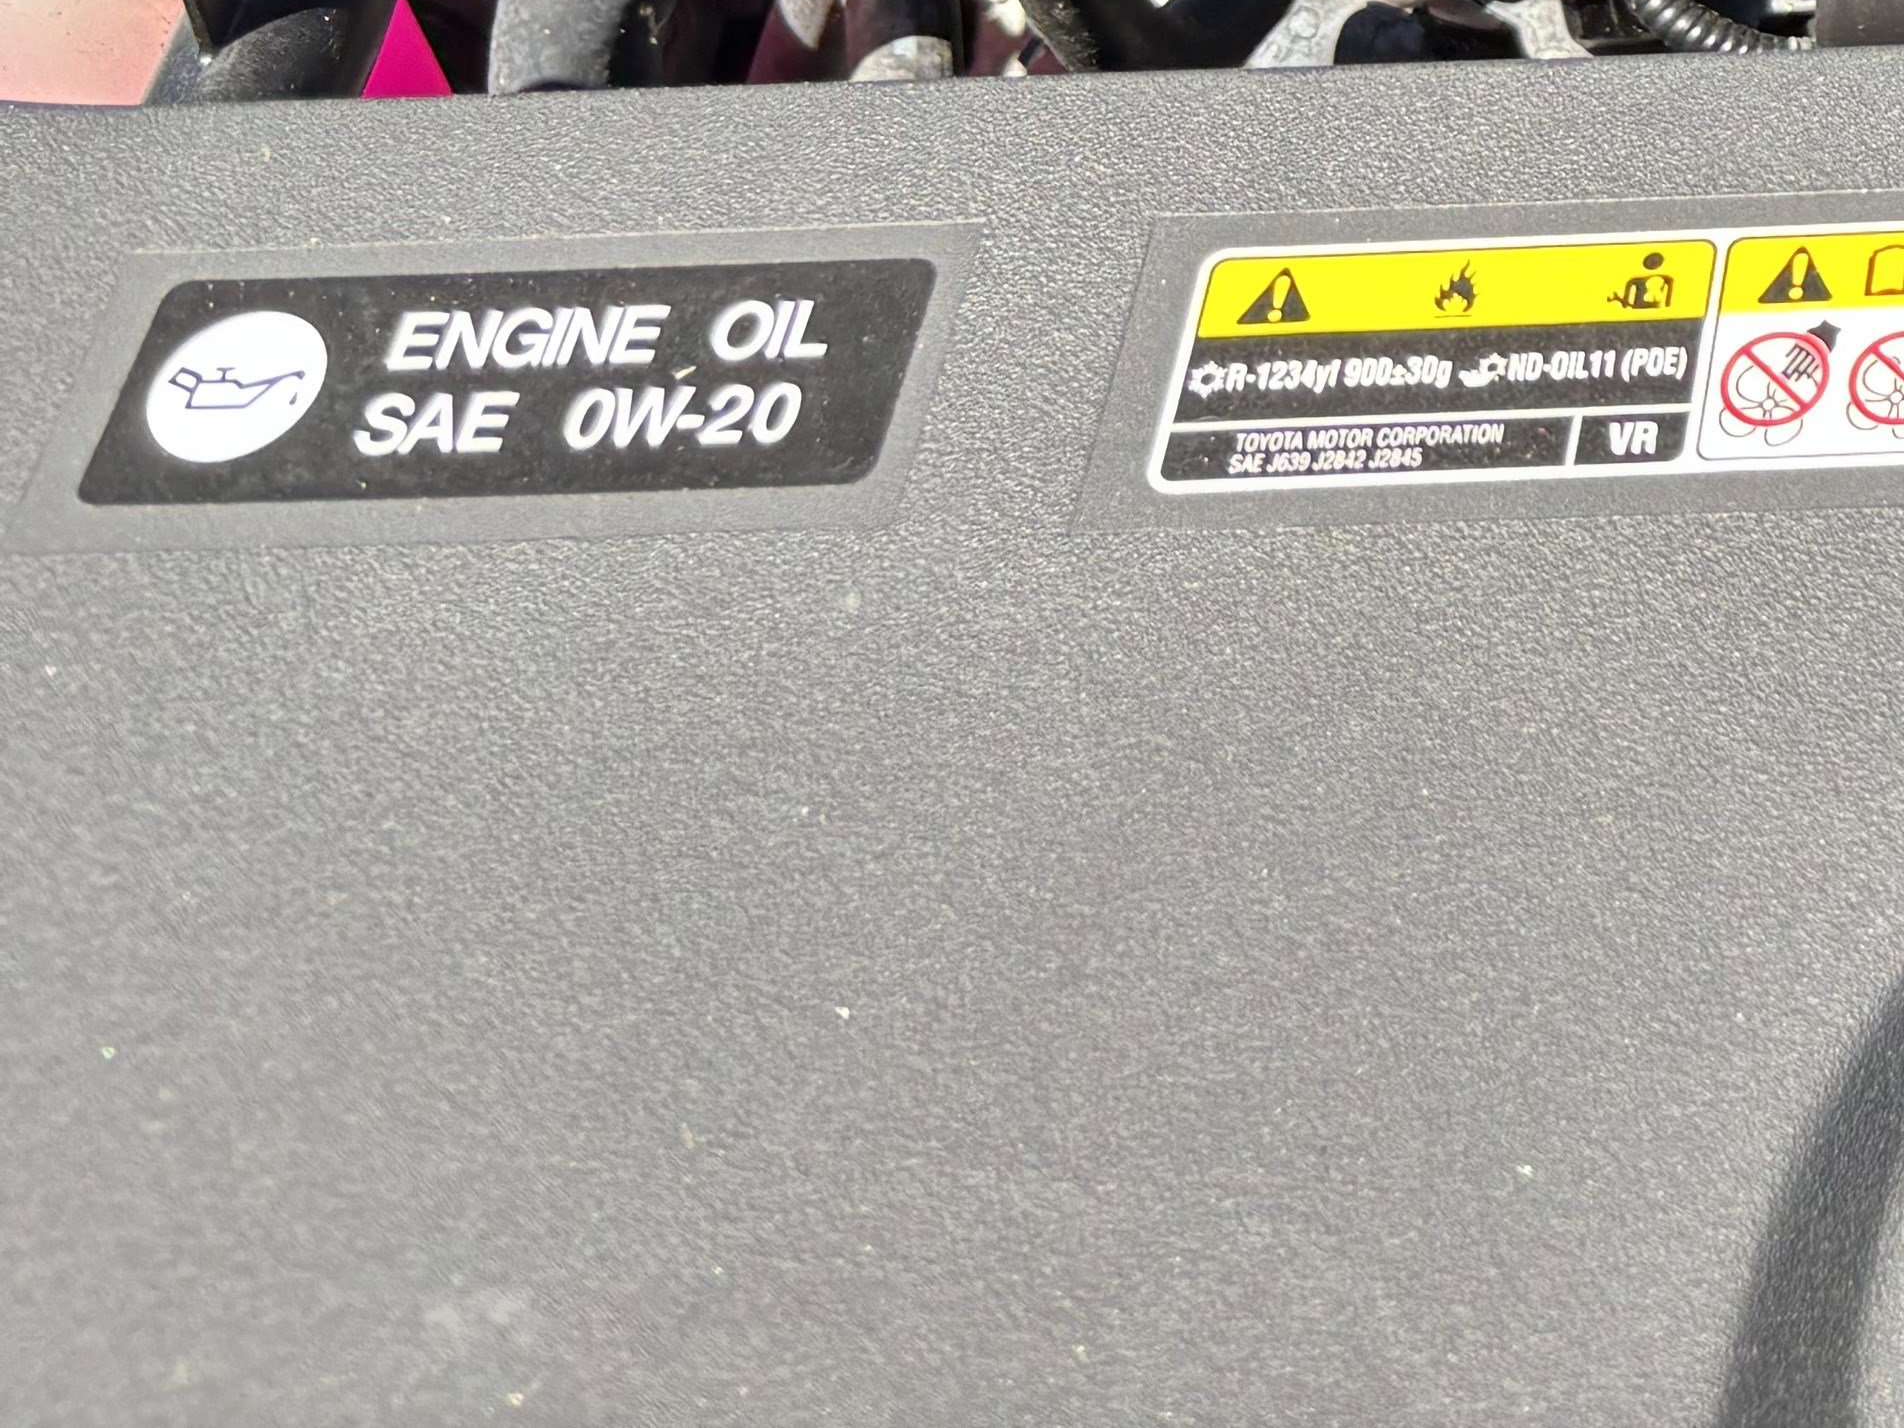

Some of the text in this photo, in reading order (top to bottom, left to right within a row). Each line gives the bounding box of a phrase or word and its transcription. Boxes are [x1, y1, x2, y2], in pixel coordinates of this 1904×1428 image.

[384, 300, 828, 373] ENGINE OIL
[1621, 347, 1688, 382] (POE)
[352, 383, 802, 457] SAE 0W-20
[1235, 423, 1505, 453] TOYOTA MOTOR CORPORATION
[1609, 421, 1659, 456] VR
[1228, 453, 1266, 475] SAE
[1265, 451, 1312, 473] J639
